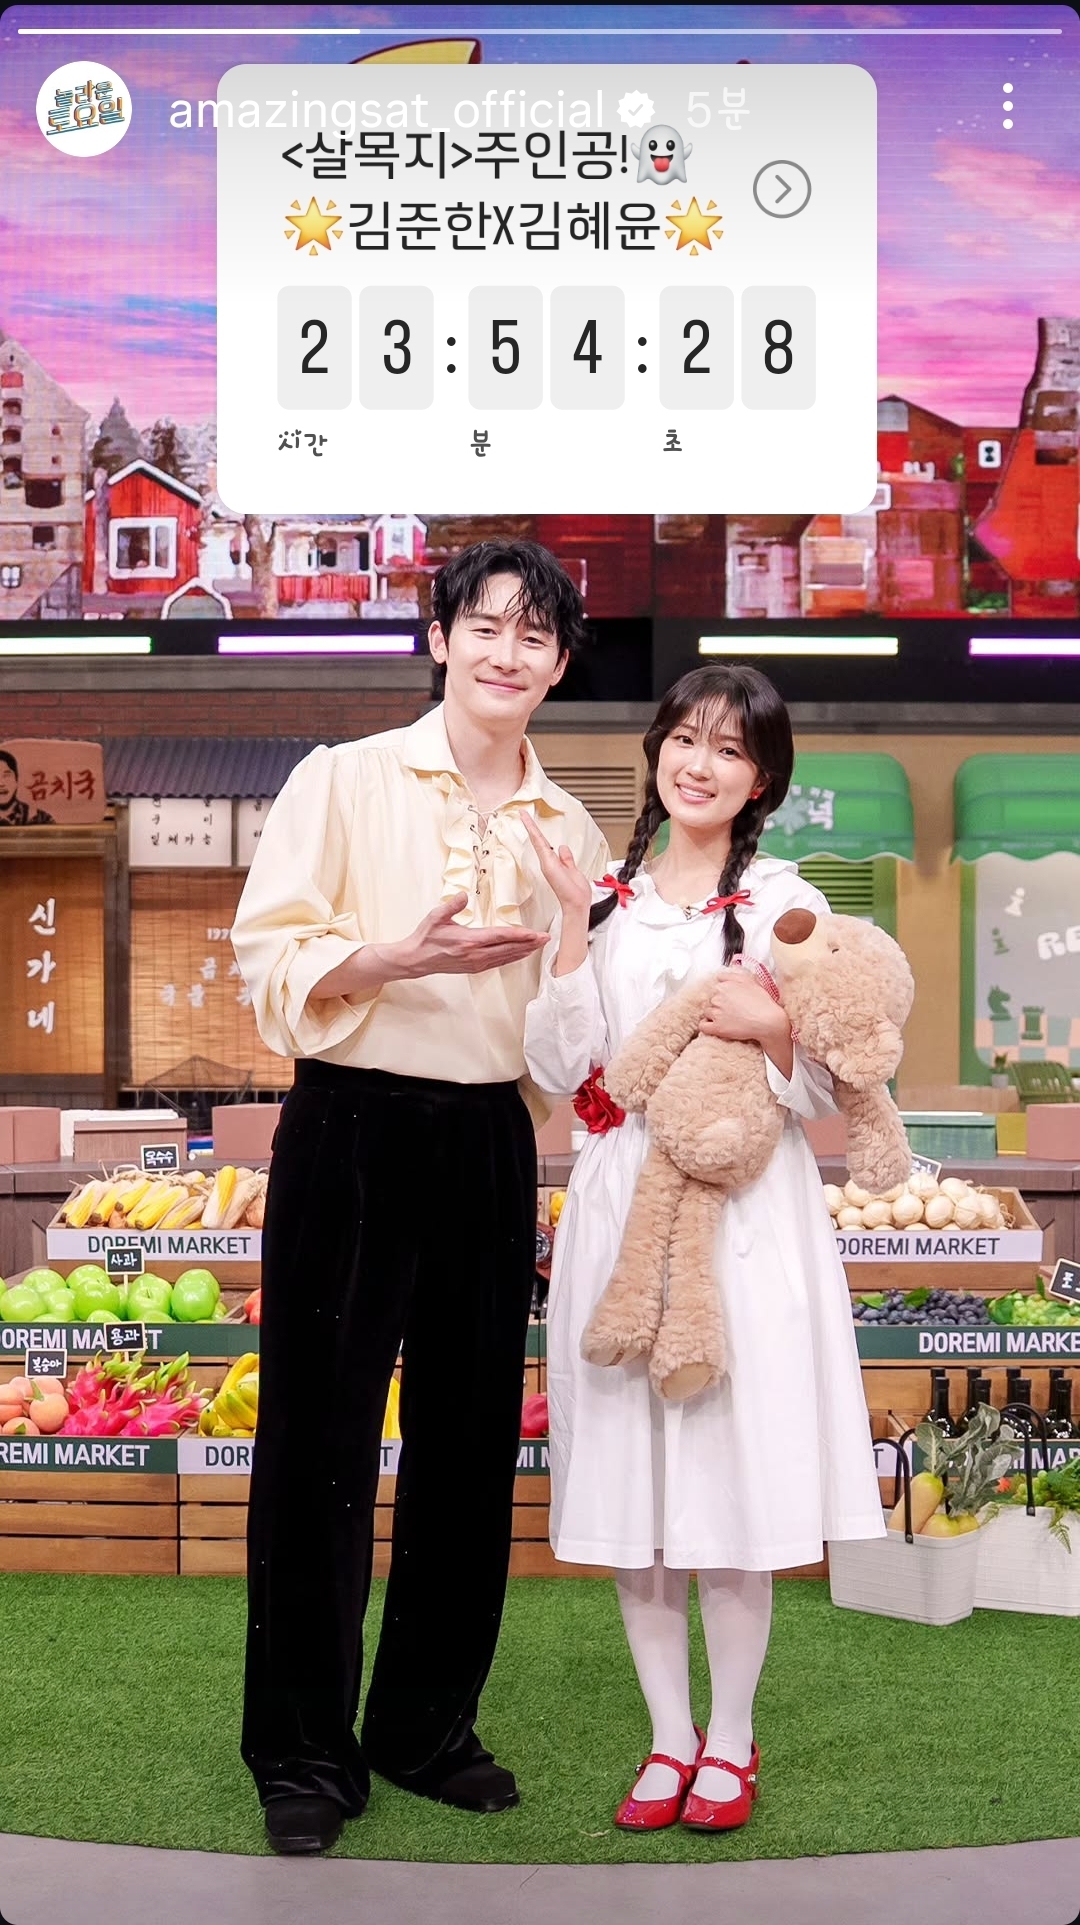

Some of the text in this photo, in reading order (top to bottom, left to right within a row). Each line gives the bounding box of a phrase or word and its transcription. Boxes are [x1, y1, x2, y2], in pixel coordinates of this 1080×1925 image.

[26, 769, 95, 800] 곰치국
[27, 897, 57, 1034] 신가네
[145, 1150, 174, 1166] 옥수수
[168, 1236, 251, 1254] MARKET
[915, 1237, 1000, 1255] MARKET
[111, 1252, 138, 1266] 사과
[1061, 1271, 1080, 1293] 포
[0, 1328, 162, 1350] OREMI MAT
[110, 1328, 140, 1346] 용과
[919, 1332, 1000, 1353] DOREMI
[32, 1356, 62, 1373] 복숭아
[54, 1443, 150, 1466] MARKET
[205, 1445, 254, 1467] DOR
